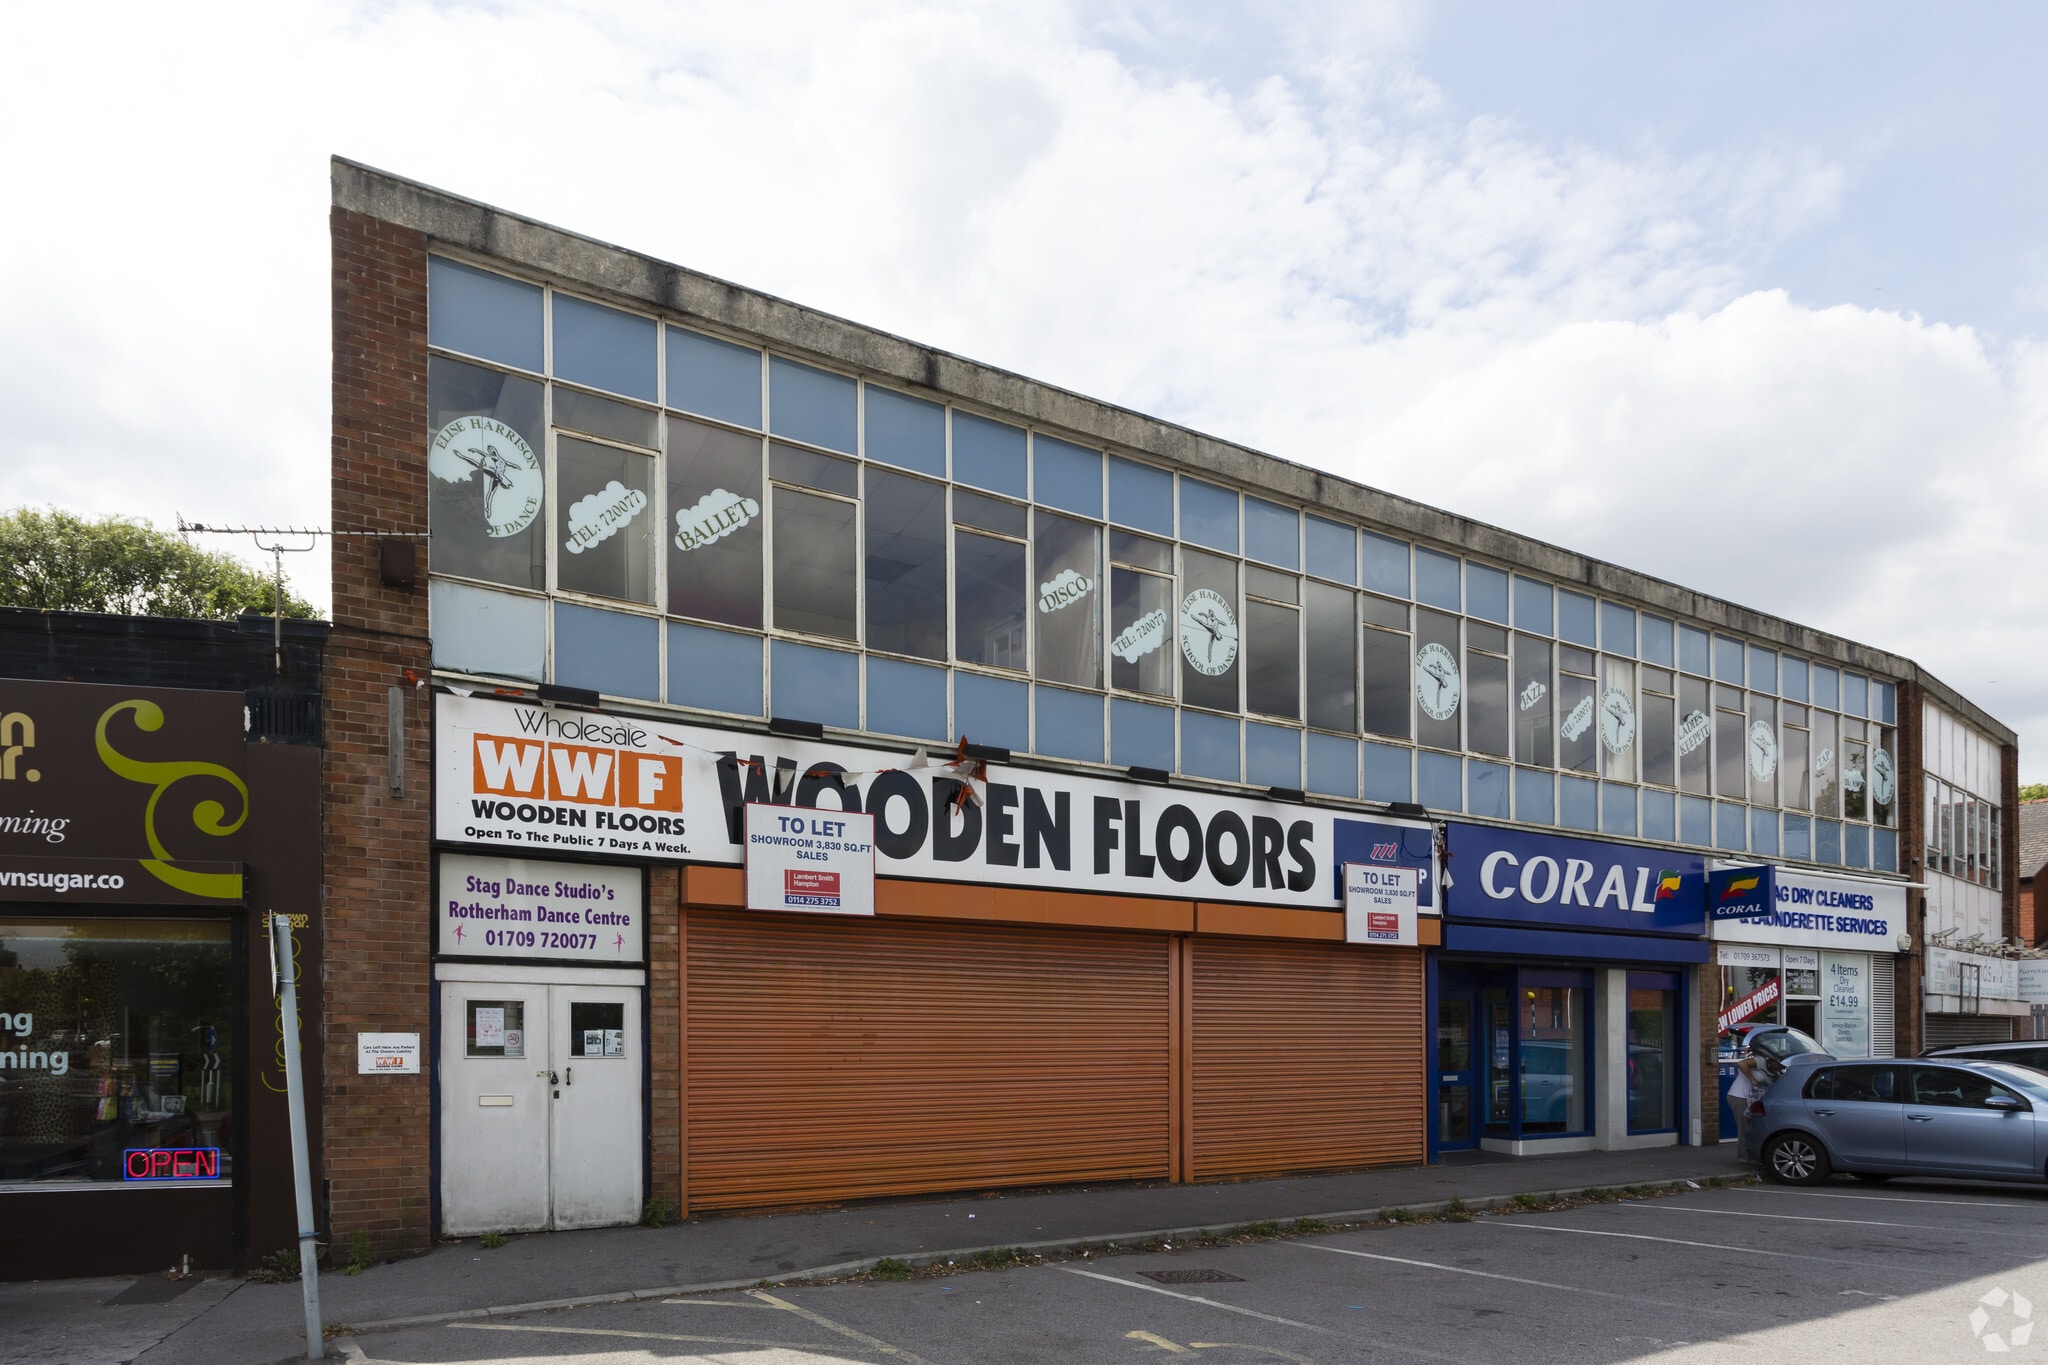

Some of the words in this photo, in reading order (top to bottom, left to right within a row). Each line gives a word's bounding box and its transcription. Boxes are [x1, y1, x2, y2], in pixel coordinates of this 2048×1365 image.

[436, 421, 466, 450] ELISE
[470, 418, 538, 470] HARRISON
[504, 496, 538, 534] DANCE
[570, 524, 601, 549] TEL:
[600, 491, 642, 526] 720077
[676, 499, 753, 551] BALLET
[1043, 576, 1088, 610] DISCO
[1182, 593, 1198, 614] ELISE
[1199, 591, 1235, 625] HARRISON
[1114, 635, 1137, 653] TEL:
[1136, 612, 1166, 639] 720077
[1182, 635, 1204, 673] SCHOOL
[1207, 667, 1216, 675] OF
[1218, 646, 1236, 672] DANCE
[1521, 685, 1543, 709] JAZZ
[514, 708, 648, 748] Wholesale
[475, 740, 667, 805] WWF
[471, 799, 587, 829] WOODEN
[596, 811, 685, 836] FLOORS
[778, 816, 805, 834] TO
[811, 820, 846, 838] LET
[464, 826, 502, 841] Open
[507, 830, 522, 841] To
[526, 832, 549, 843] The
[553, 834, 594, 847] Public
[598, 838, 605, 847] 7
[609, 839, 639, 851] Days
[642, 841, 652, 851] A
[655, 842, 691, 854] Week.
[750, 834, 814, 849] SHOWROOM
[816, 839, 842, 852] 3,830
[843, 842, 872, 854] SQ.FT
[1093, 795, 1316, 892] FLOORS
[796, 850, 829, 862] SALES
[466, 875, 501, 898] Stag
[506, 878, 550, 897] Dance
[554, 881, 615, 900] Studio's
[793, 873, 818, 881] Lambert
[793, 880, 819, 888] Hampton
[1363, 872, 1378, 885] TO
[1382, 873, 1400, 887] LET
[1480, 850, 1656, 912] CORAL
[788, 896, 804, 904] 0114
[805, 897, 819, 905] 275
[820, 898, 837, 906] 3752
[1348, 885, 1383, 895] SHOWROOM
[1373, 896, 1392, 905] SALES
[1792, 887, 1814, 905] DRY
[1816, 890, 1874, 911] CLEANERS
[449, 901, 532, 922] Rotherham
[537, 906, 580, 924] Dance
[584, 909, 630, 926] Centre
[1716, 904, 1762, 915] CORAL
[1836, 916, 1888, 936] SERVICES
[485, 929, 536, 947] 01709
[540, 932, 597, 950] 720077
[1719, 951, 1729, 960] Tel:
[1733, 952, 1750, 961] 01709
[1785, 955, 1799, 964] Open
[1803, 956, 1816, 965] Days
[1830, 963, 1836, 975] 4
[1837, 964, 1858, 977] Items
[1840, 976, 1849, 986] Dry
[1833, 984, 1854, 994] Cleaned
[1728, 998, 1753, 1026] LOWER
[1752, 982, 1778, 1010] PRICES
[1830, 995, 1858, 1008] £14.99
[127, 1150, 215, 1178] OPEN
